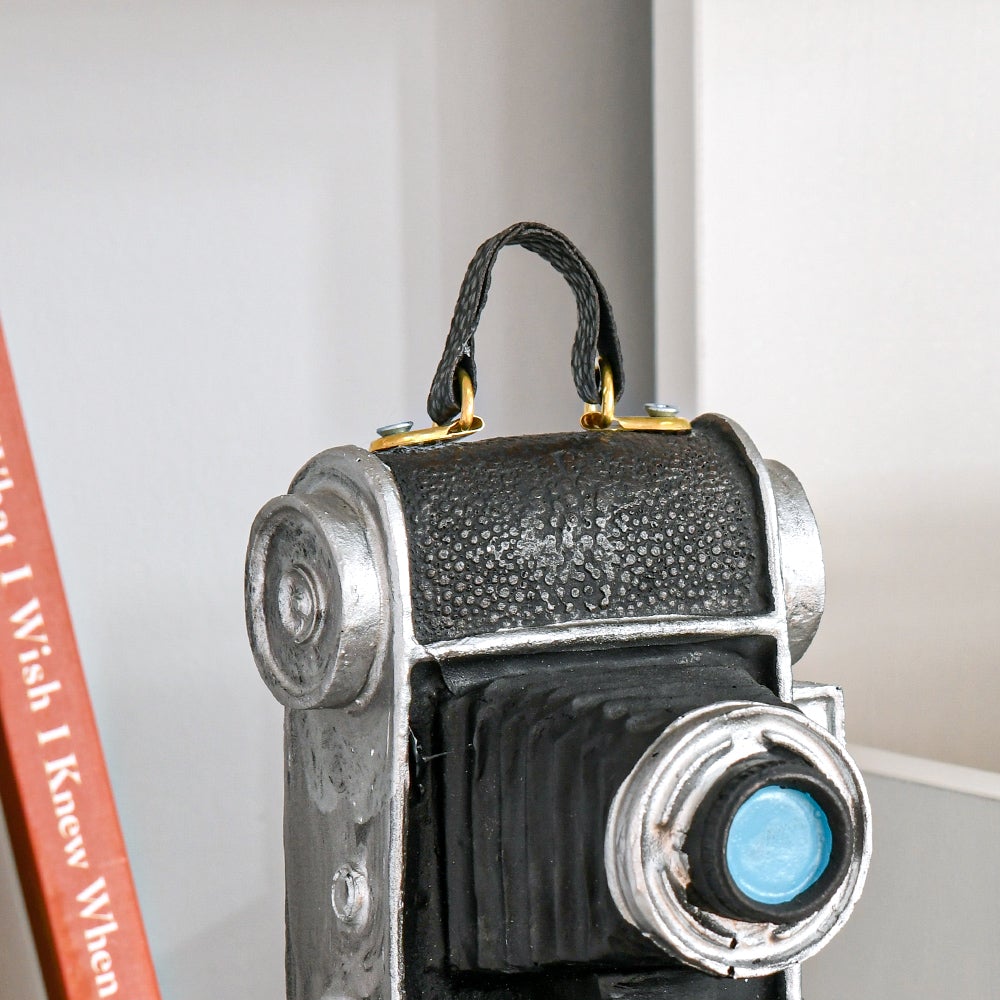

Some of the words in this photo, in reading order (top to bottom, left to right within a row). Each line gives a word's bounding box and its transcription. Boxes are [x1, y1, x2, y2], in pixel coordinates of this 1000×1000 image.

[10, 597, 62, 712] Wish
[37, 723, 71, 746] I
[44, 752, 89, 869] Knew
[76, 876, 119, 998] When
